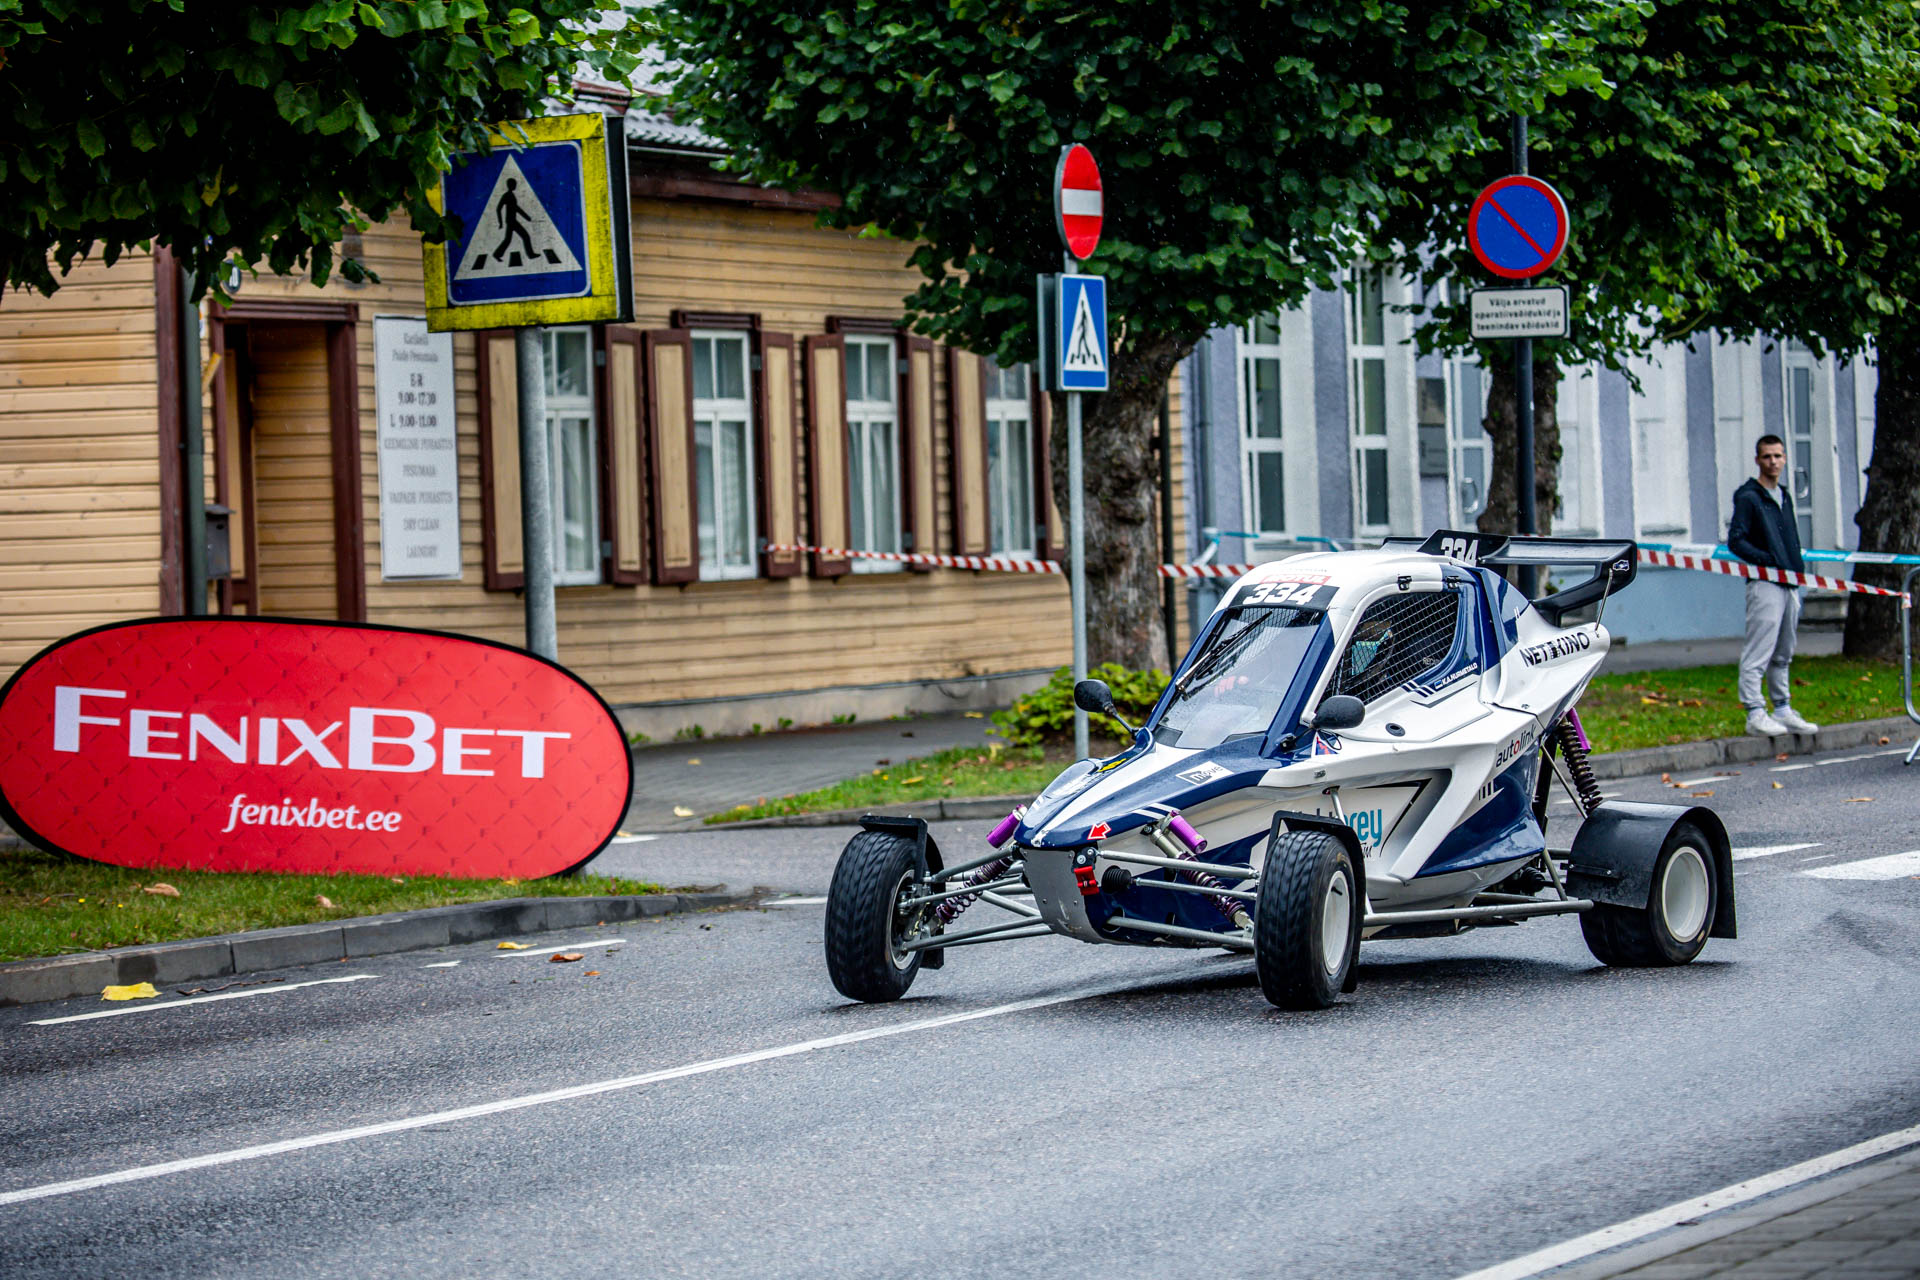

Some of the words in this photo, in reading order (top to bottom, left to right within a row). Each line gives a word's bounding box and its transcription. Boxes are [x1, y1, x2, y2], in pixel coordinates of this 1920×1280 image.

[1489, 297, 1511, 308] Välja
[1513, 297, 1546, 306] arvatud
[1440, 537, 1479, 567] 334
[1242, 582, 1324, 605] 334
[1496, 723, 1537, 768] autolink
[221, 793, 402, 832] fenixbet.ee
